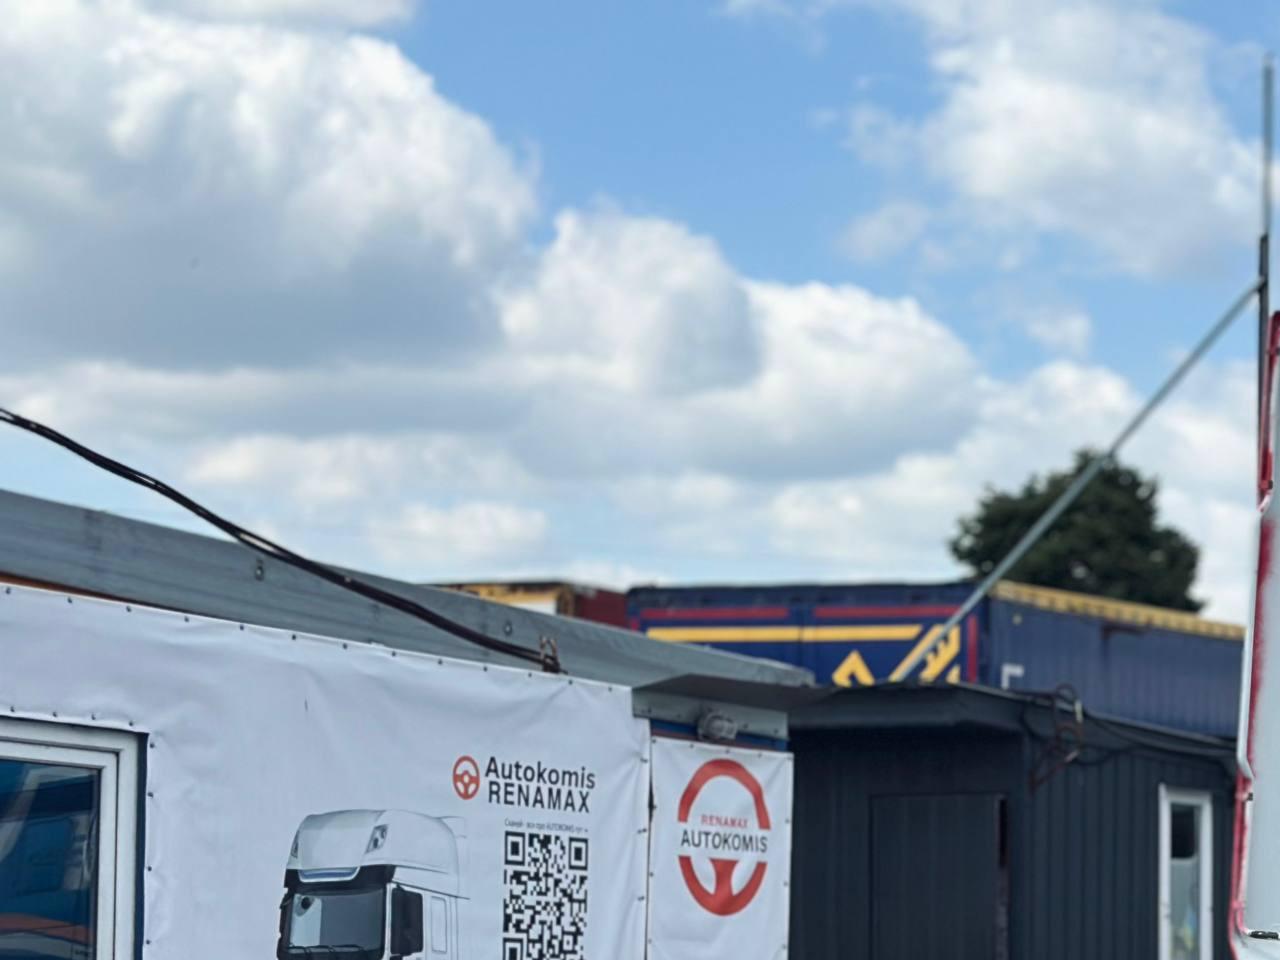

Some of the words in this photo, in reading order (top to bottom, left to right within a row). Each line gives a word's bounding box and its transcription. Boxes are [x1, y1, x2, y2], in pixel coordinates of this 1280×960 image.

[485, 756, 596, 789] Autokomis
[488, 781, 590, 813] RENAMAX
[681, 829, 768, 853] AUTOKOMIS
